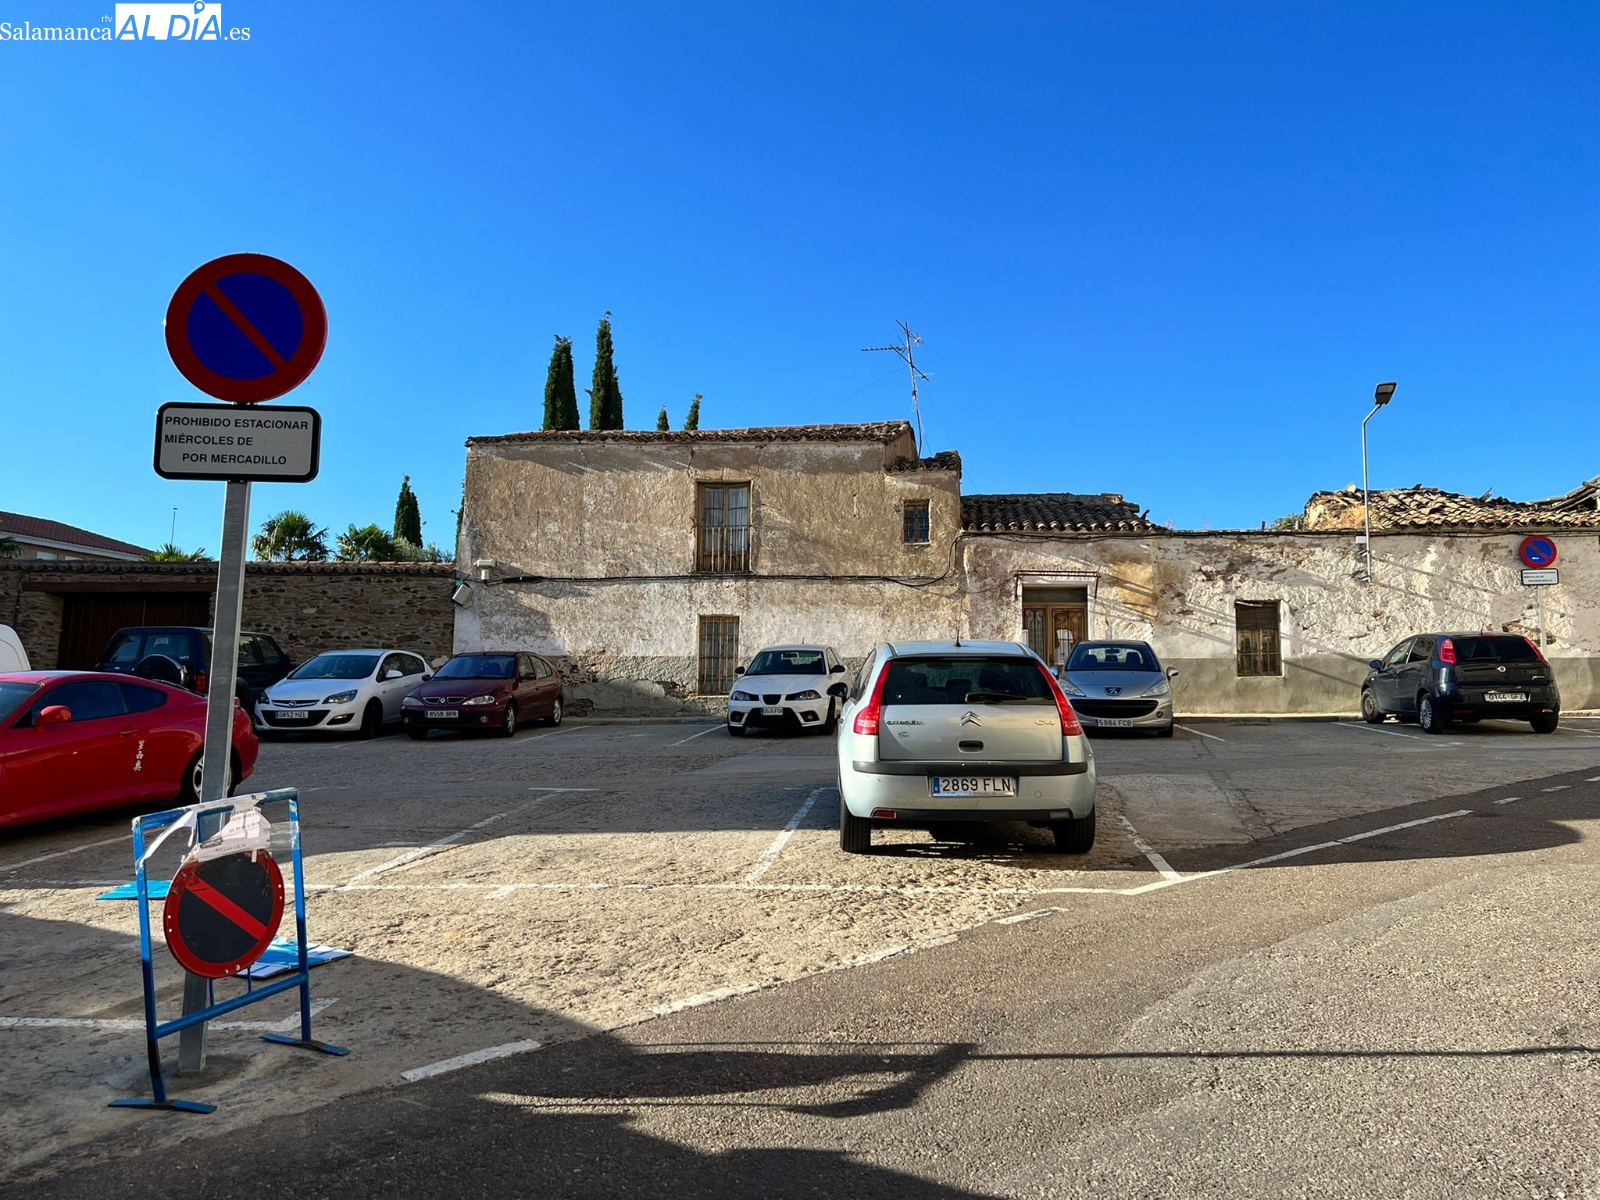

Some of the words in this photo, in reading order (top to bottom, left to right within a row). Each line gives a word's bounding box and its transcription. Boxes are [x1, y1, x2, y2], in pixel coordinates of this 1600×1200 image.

[164, 416, 231, 428] PROHIBIDO
[234, 418, 309, 430] ESTACIONAR
[164, 433, 234, 445] MIÉRCOLES
[237, 436, 253, 446] DE
[182, 453, 208, 463] POR
[210, 454, 287, 465] MERCADILLO
[1099, 719, 1117, 727] 5984
[1118, 719, 1132, 727] FCB
[941, 778, 979, 792] 2869
[983, 778, 1011, 792] FLN
